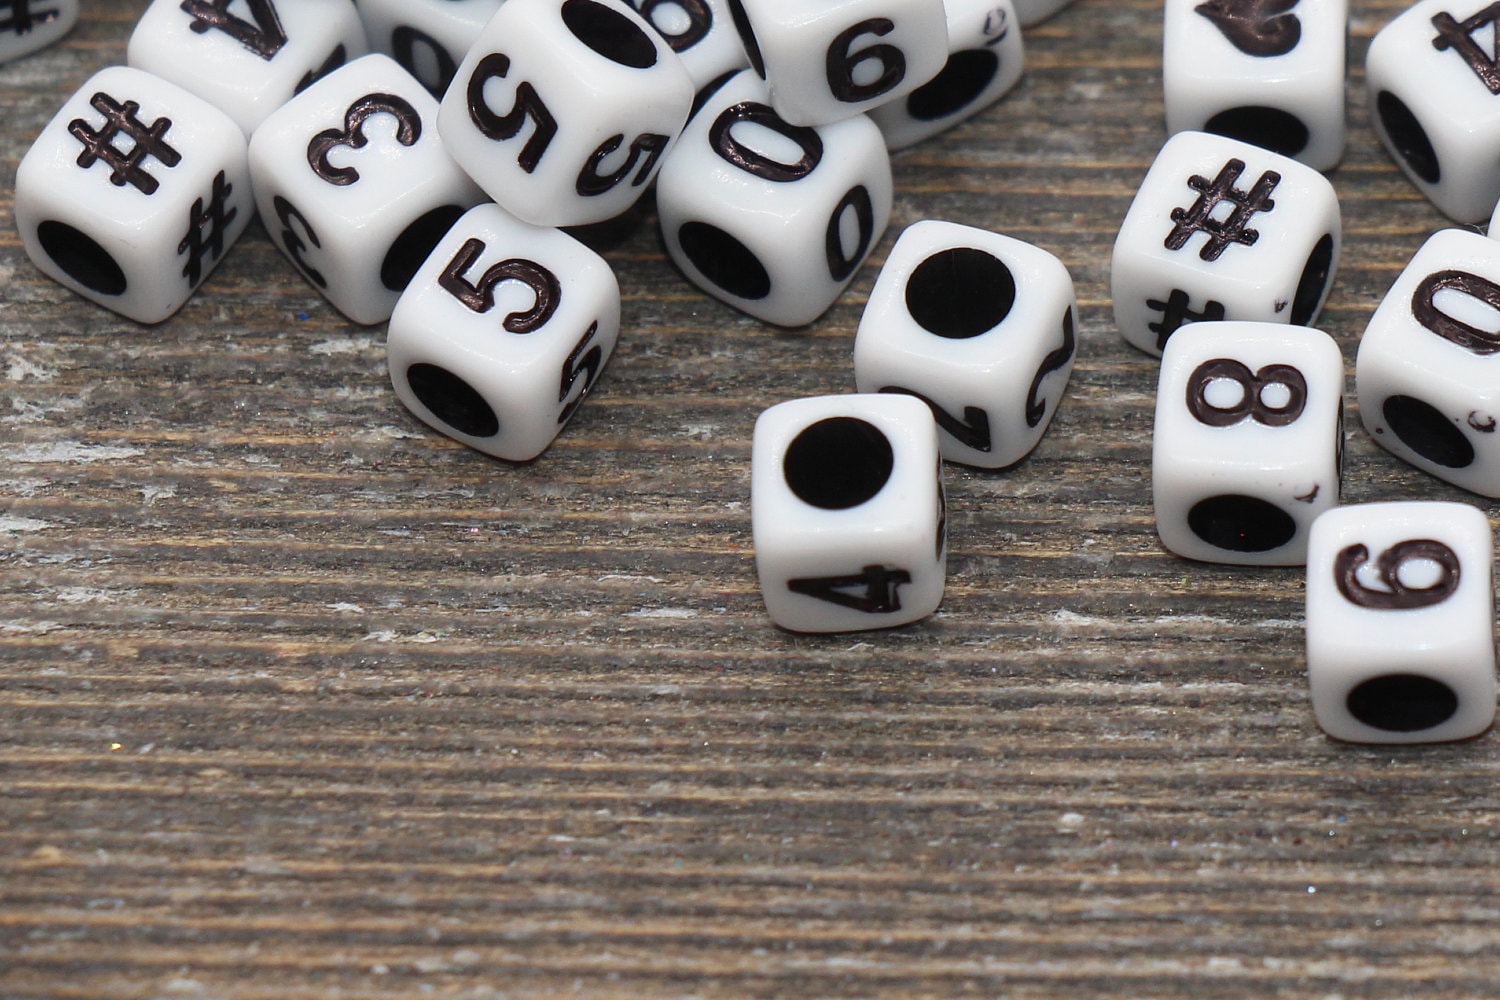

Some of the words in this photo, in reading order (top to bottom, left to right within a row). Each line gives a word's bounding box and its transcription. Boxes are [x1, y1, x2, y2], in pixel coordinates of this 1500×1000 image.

[825, 18, 906, 103] 6
[68, 92, 182, 195] #
[307, 93, 422, 186] 3
[467, 53, 558, 174] 5
[708, 100, 824, 183] 0
[575, 132, 670, 198] 5
[1164, 158, 1281, 262] #
[178, 168, 238, 290] #
[825, 184, 875, 283] 0
[438, 238, 561, 334] 5
[1186, 358, 1308, 427] 8
[787, 564, 912, 614] 4
